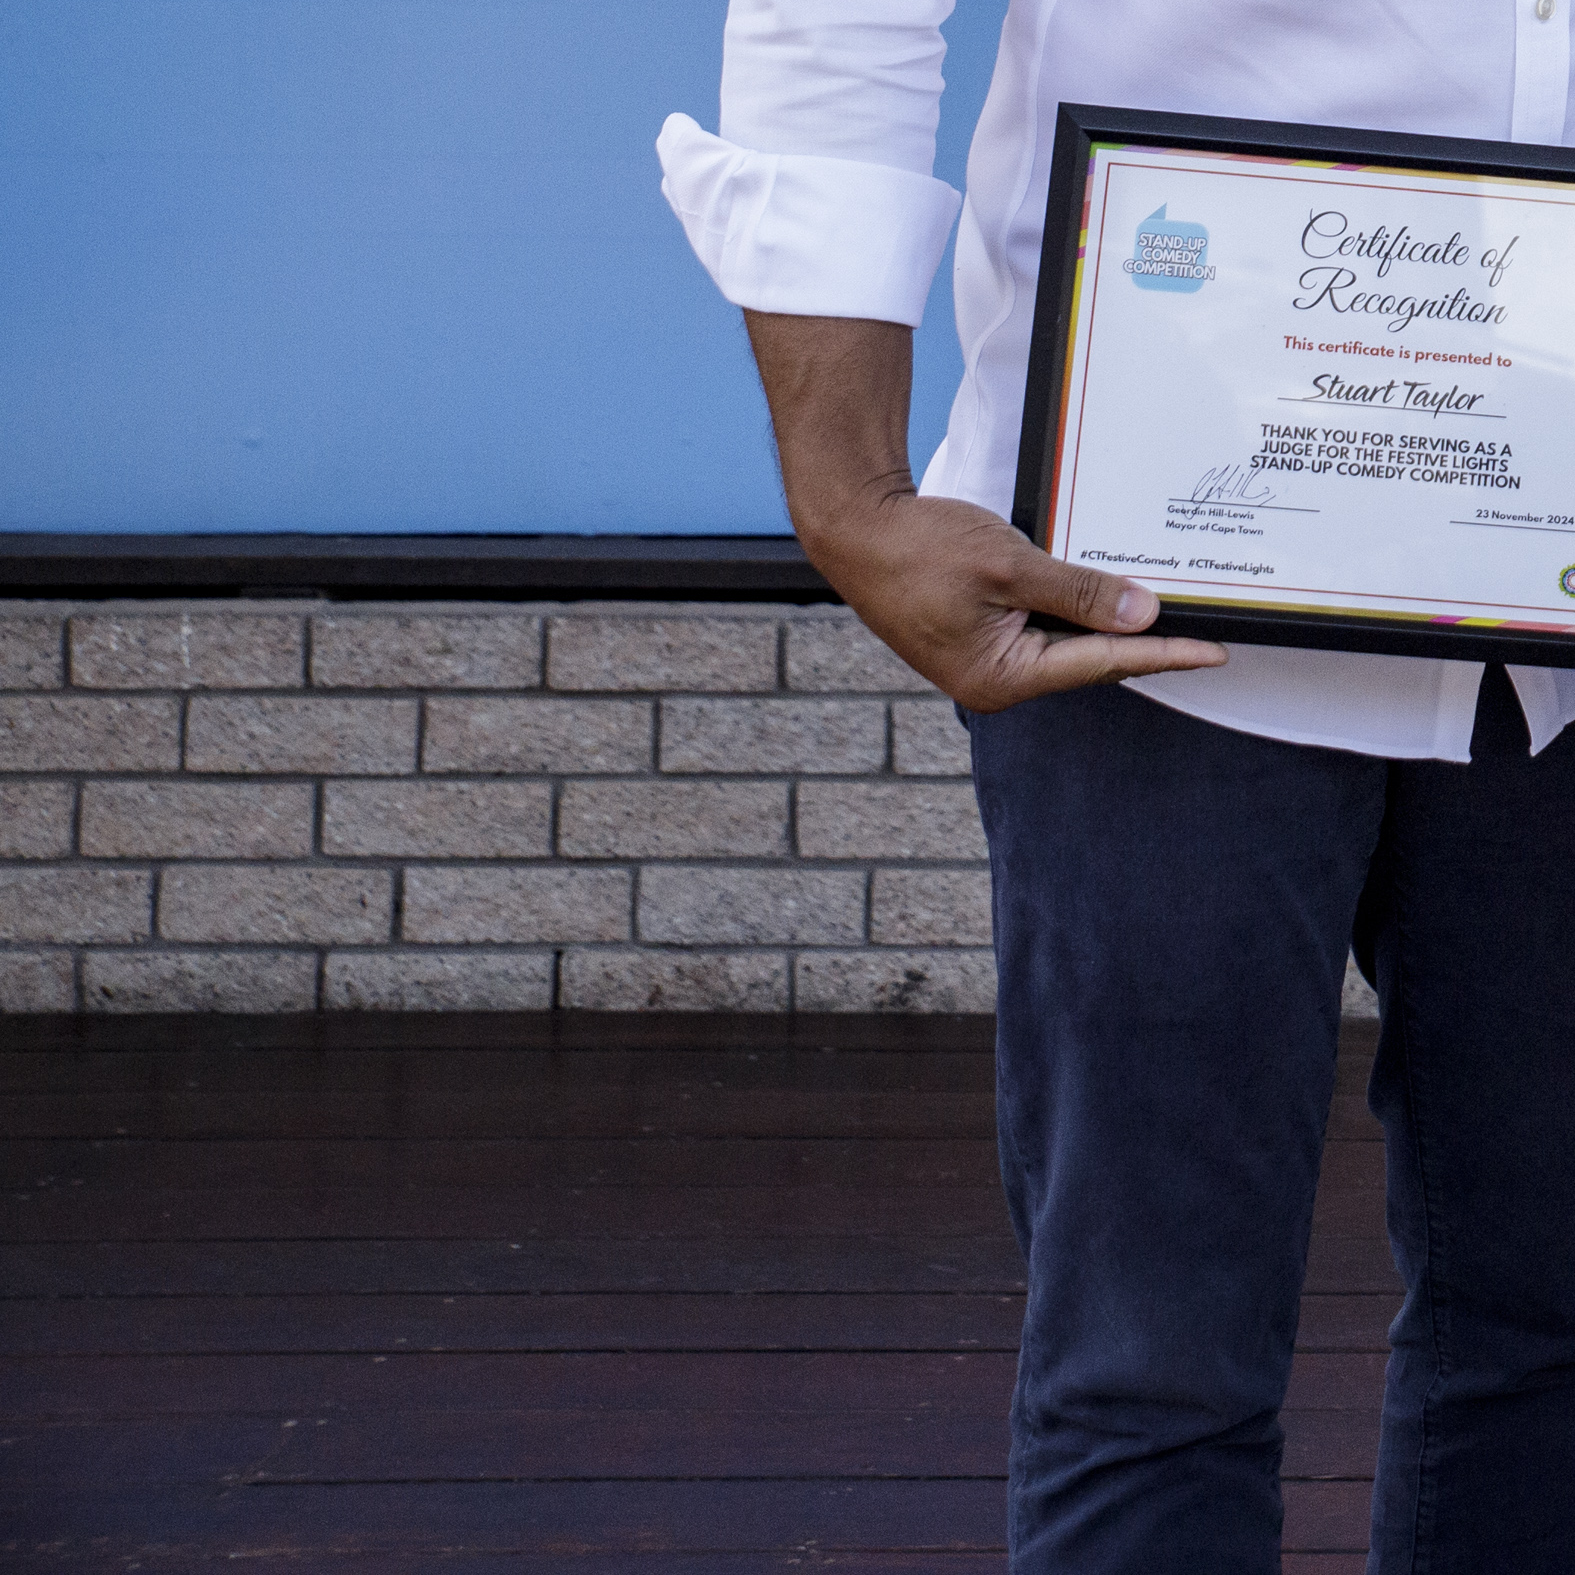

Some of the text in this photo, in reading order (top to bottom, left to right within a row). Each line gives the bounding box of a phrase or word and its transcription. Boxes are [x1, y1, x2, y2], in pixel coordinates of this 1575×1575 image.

[1137, 232, 1208, 253] STAND-UP
[1141, 246, 1201, 266] COMEDY
[1301, 209, 1520, 288] Certificate of
[1122, 258, 1217, 282] COMPETITION
[1292, 266, 1507, 333] Recognition
[1284, 335, 1512, 367] This certificate is presented to
[1308, 374, 1484, 419] Stuart Taylor
[1261, 424, 1512, 457] THANK YOU FOR SERVING AS A
[1260, 440, 1508, 473] JUDGE FOR THE FESTIVE LIGHTS
[1250, 455, 1521, 489] STAND-UP COMEDY COMPETITION
[1165, 520, 1264, 535] Mayor of Cape Town
[1208, 508, 1254, 520] Hill-Lewis
[1476, 509, 1574, 525] 23 November 2024
[1080, 550, 1274, 576] #CTFestiveComedy #CTFestiveLights
